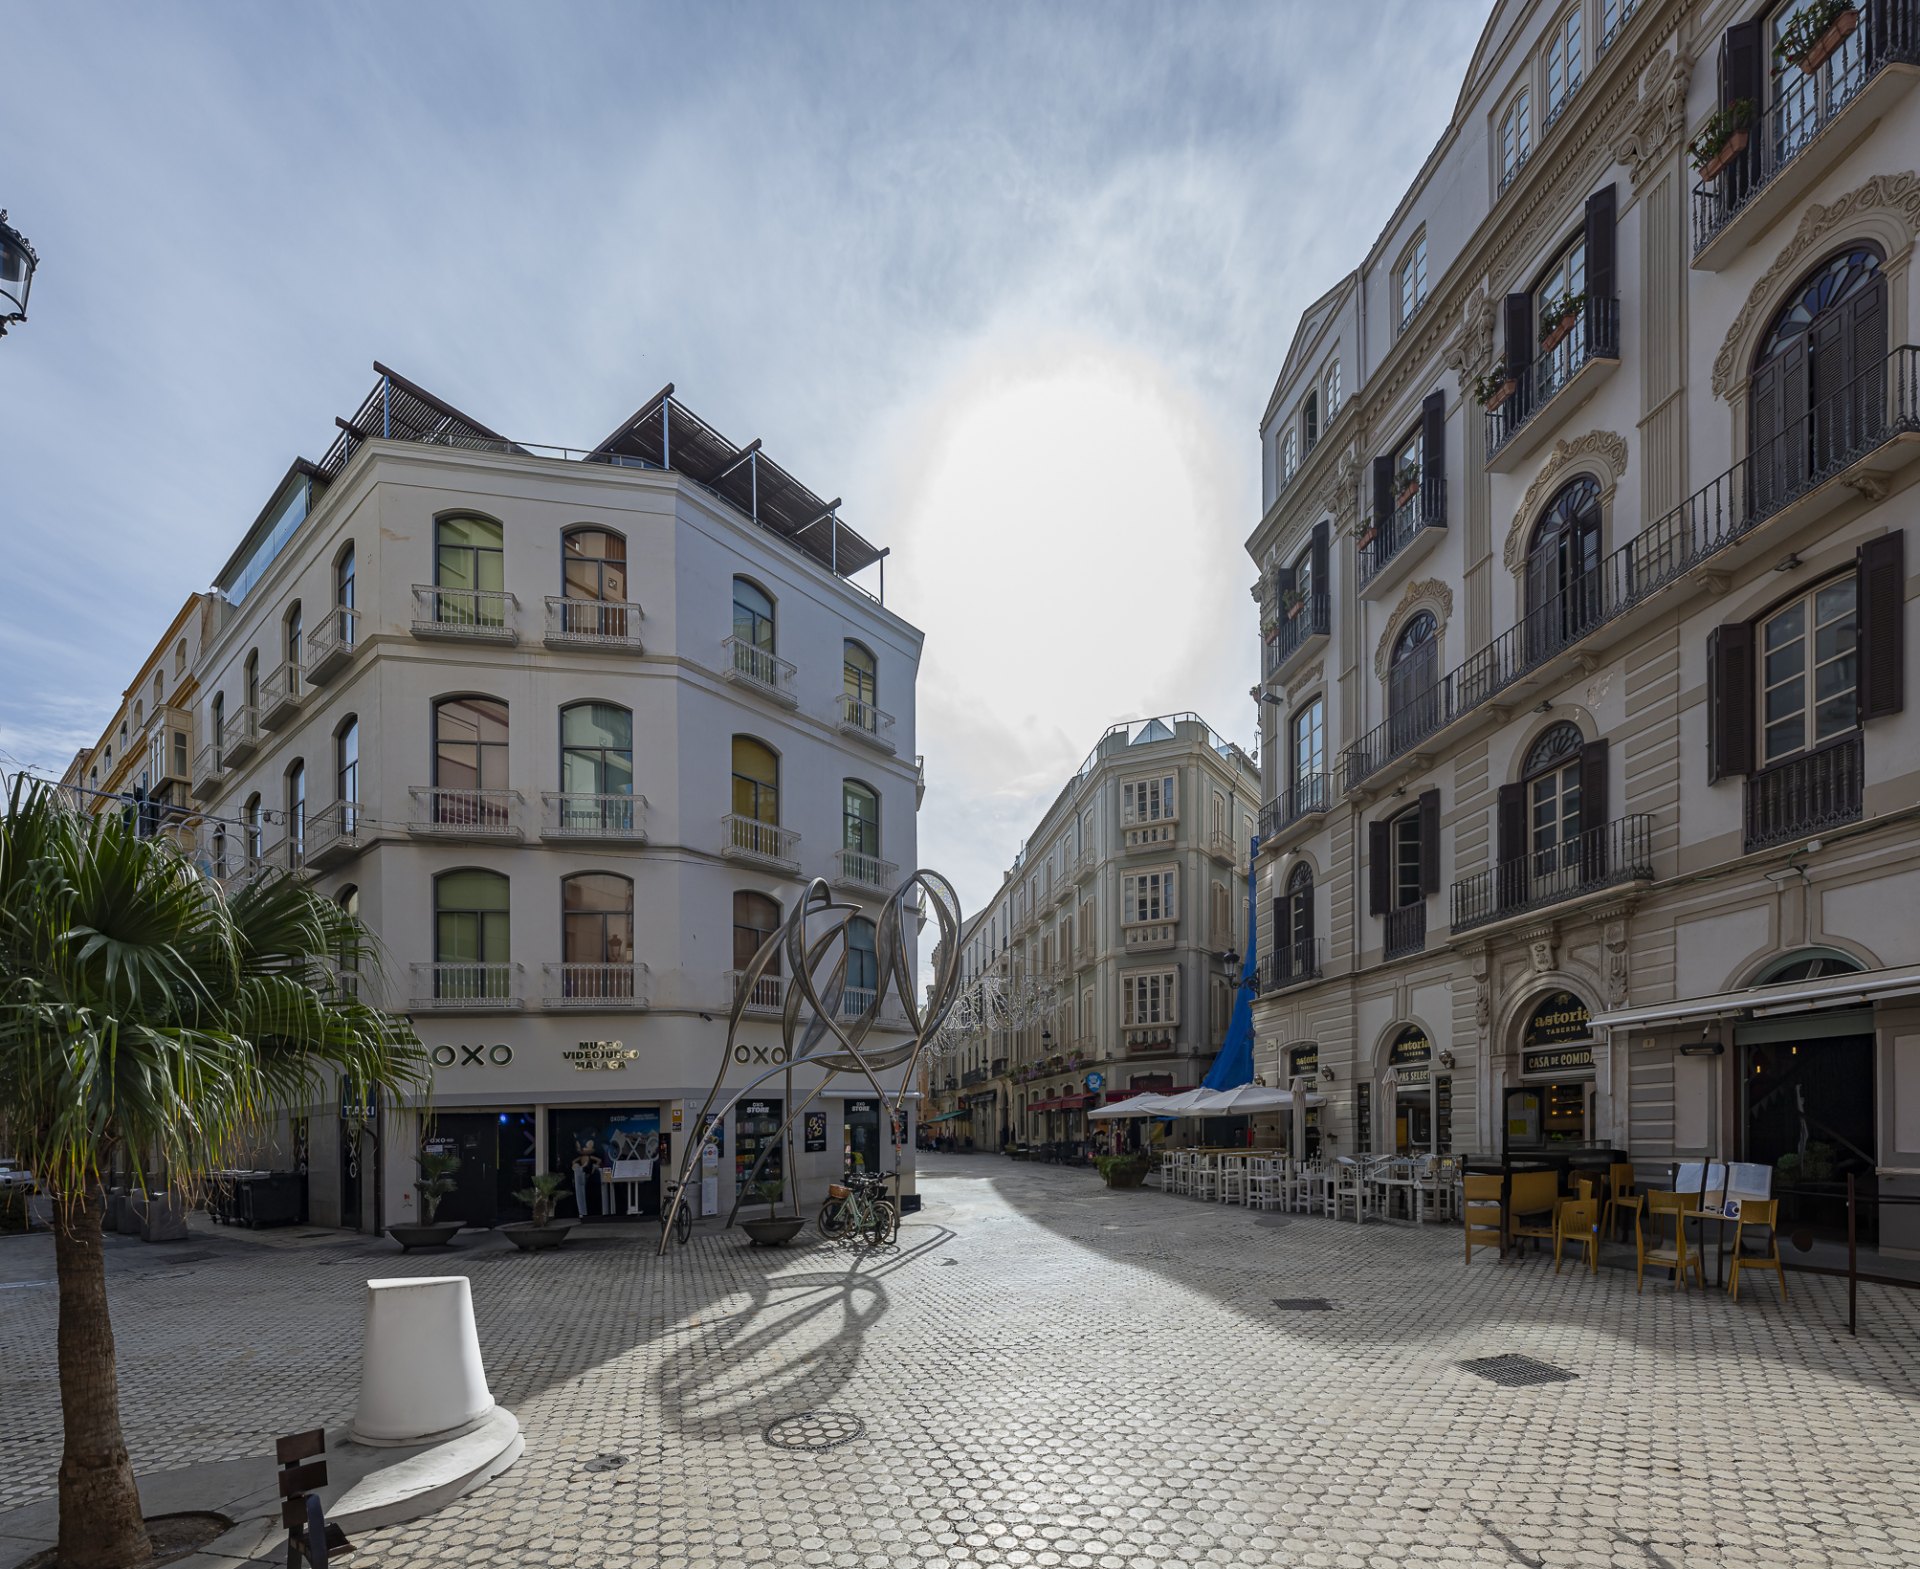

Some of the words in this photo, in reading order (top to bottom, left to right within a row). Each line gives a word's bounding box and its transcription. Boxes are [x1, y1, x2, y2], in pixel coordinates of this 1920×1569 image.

[1534, 1006, 1590, 1028] astoria
[1546, 1024, 1582, 1035] TABERNA
[431, 1044, 514, 1068] OXO
[562, 1049, 640, 1060] VIDEOJUEGO
[733, 1044, 787, 1065] OXO
[1528, 1056, 1549, 1069] CASA
[1550, 1056, 1559, 1065] DE
